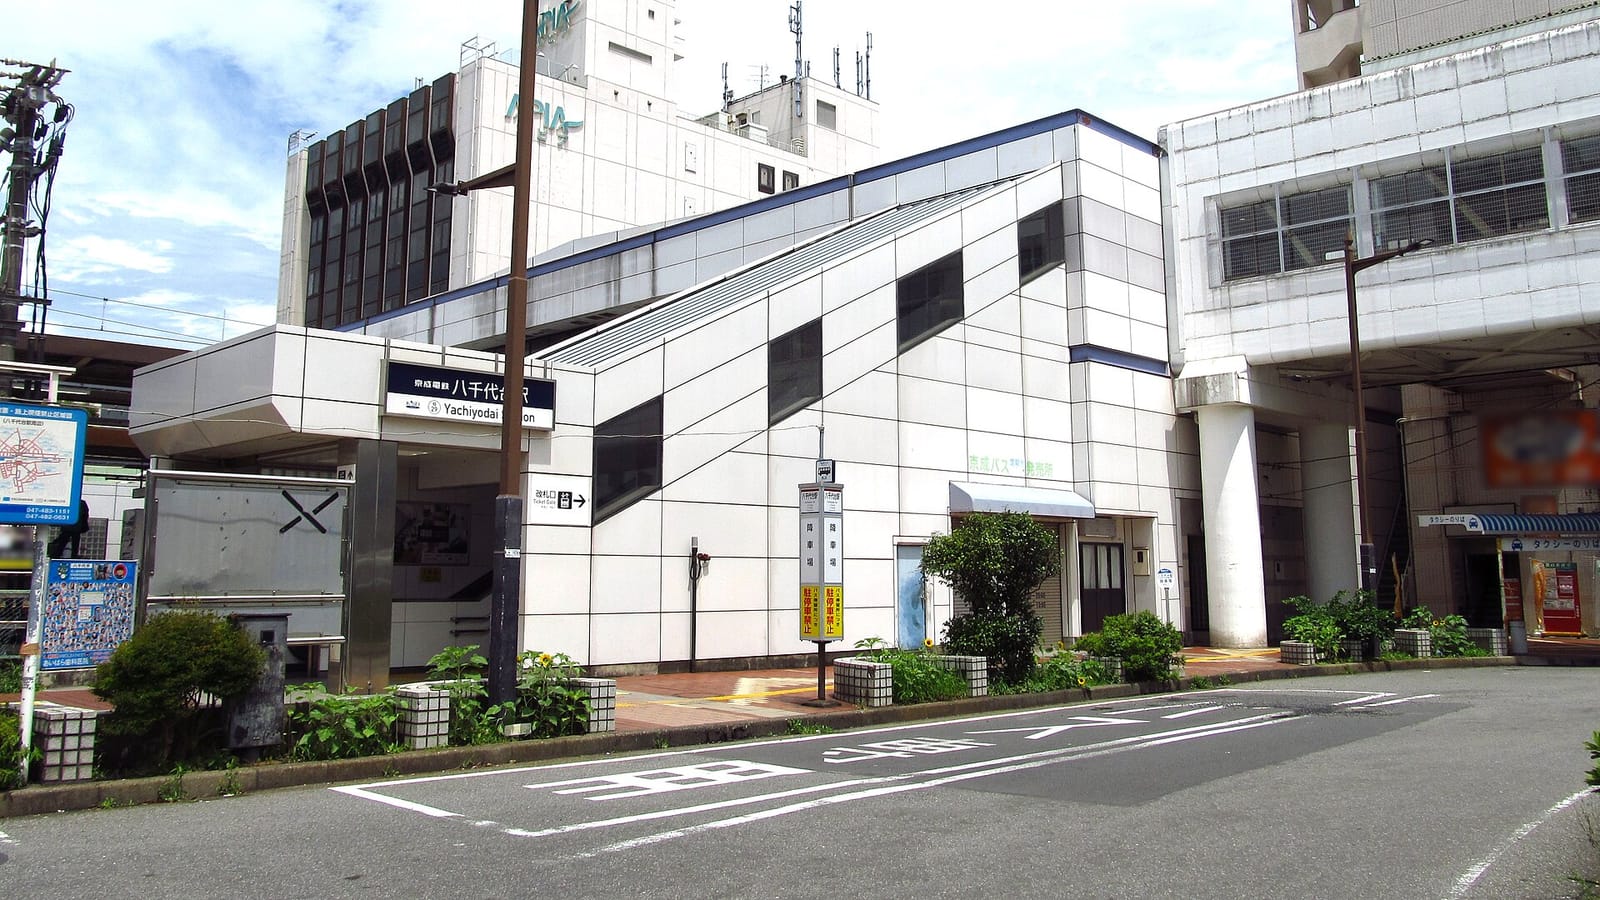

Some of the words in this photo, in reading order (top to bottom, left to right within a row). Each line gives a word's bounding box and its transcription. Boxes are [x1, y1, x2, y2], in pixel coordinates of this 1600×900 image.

[414, 379, 450, 391] 京成電鉄
[444, 403, 499, 423] Yachiyodai
[535, 489, 557, 499] 改札口
[803, 588, 812, 634] 駐停車禁止
[826, 588, 834, 634] 駐停車禁止
